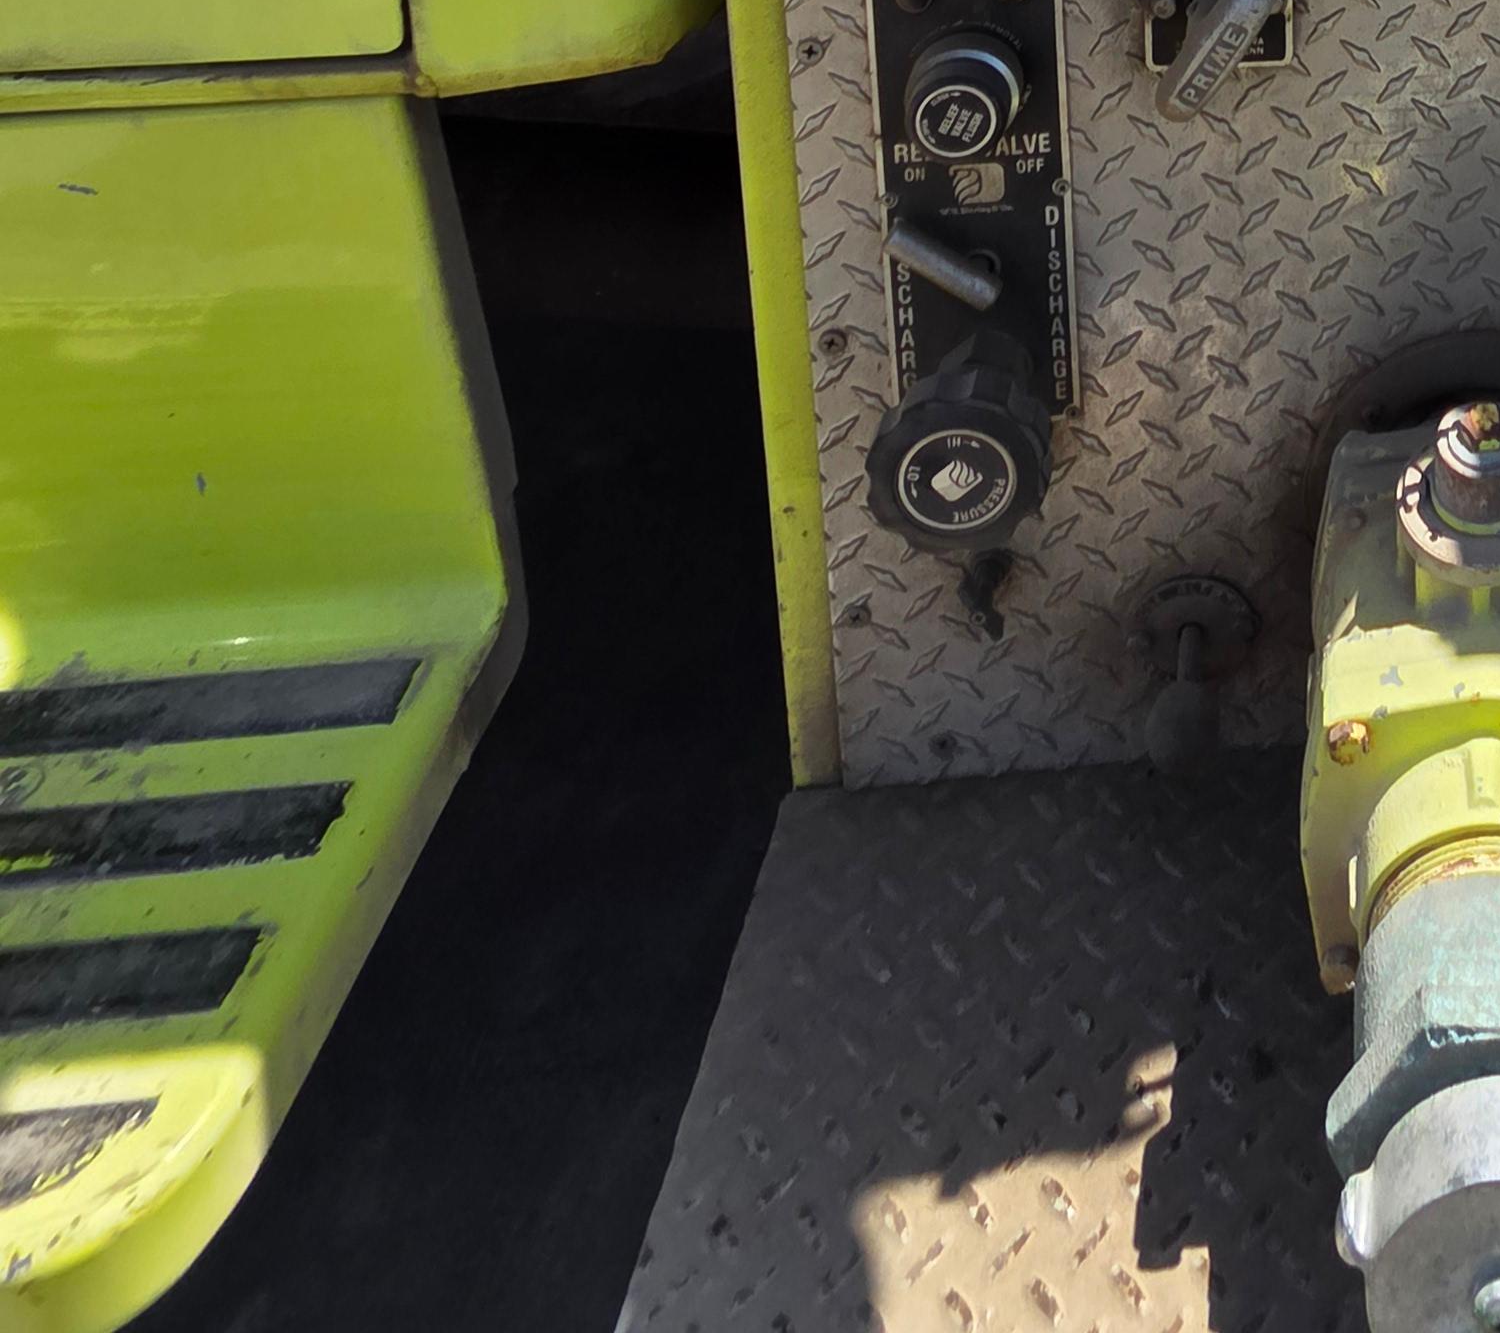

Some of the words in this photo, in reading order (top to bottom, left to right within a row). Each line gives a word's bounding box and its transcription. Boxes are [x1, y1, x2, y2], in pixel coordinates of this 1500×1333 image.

[1181, 26, 1246, 104] PRIME
[986, 133, 1052, 159] ALVE
[903, 167, 925, 182] ON
[1015, 158, 1046, 175] OFF
[1044, 204, 1069, 401] DISCHARGE
[952, 478, 1007, 523] PRESSURE
